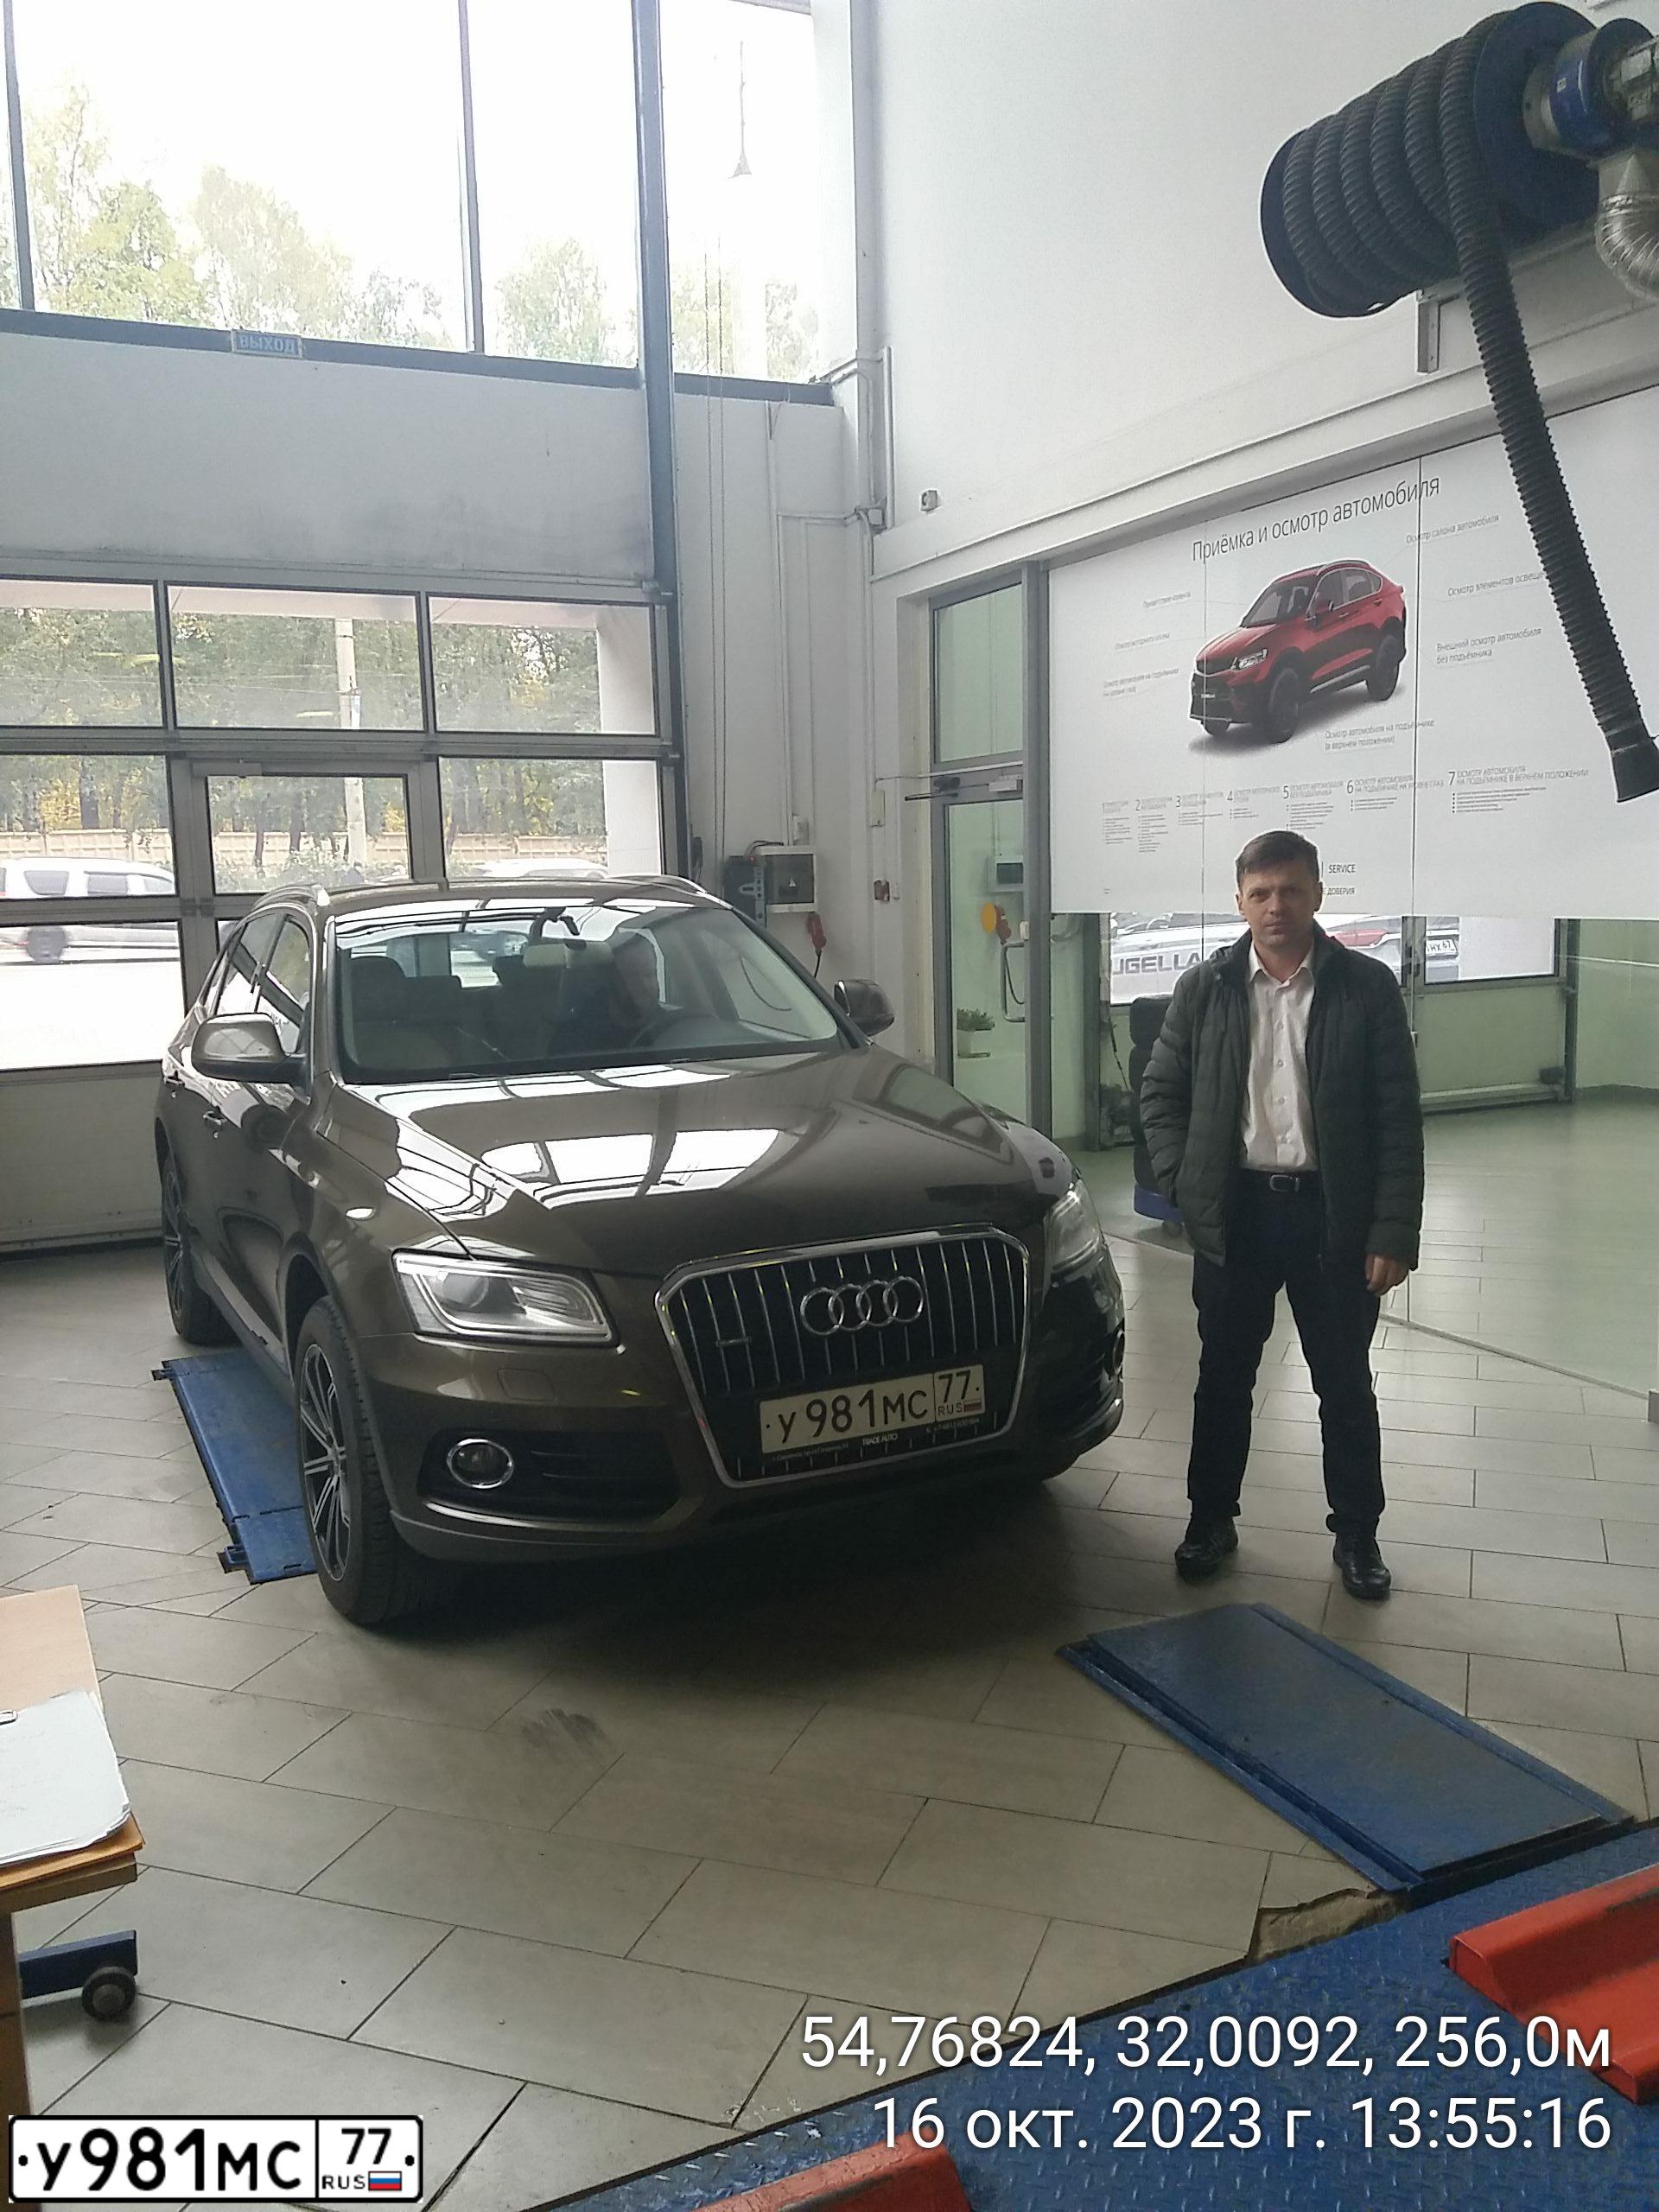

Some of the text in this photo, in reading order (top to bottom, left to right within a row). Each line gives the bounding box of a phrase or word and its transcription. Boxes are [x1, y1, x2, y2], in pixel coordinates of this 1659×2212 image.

[239, 334, 296, 355] ВЫХОД
[1192, 477, 1440, 563] Приёмка и осмотр автомобиля
[1447, 584, 1474, 596] Осмотр
[1448, 771, 1456, 785] 7
[1282, 785, 1290, 799] 5
[1346, 779, 1354, 794] 6
[1175, 795, 1182, 808] 3
[1226, 790, 1234, 802] 4
[1135, 798, 1141, 811] 2
[1328, 863, 1356, 874] SERVICE
[1327, 887, 1355, 896] ДОВЕРИЯ
[1113, 952, 1201, 976] UGELLA
[938, 1370, 971, 1403] 77
[938, 1402, 963, 1416] RUS
[779, 1389, 928, 1444] У981МС
[881, 1433, 899, 1442] AUTO
